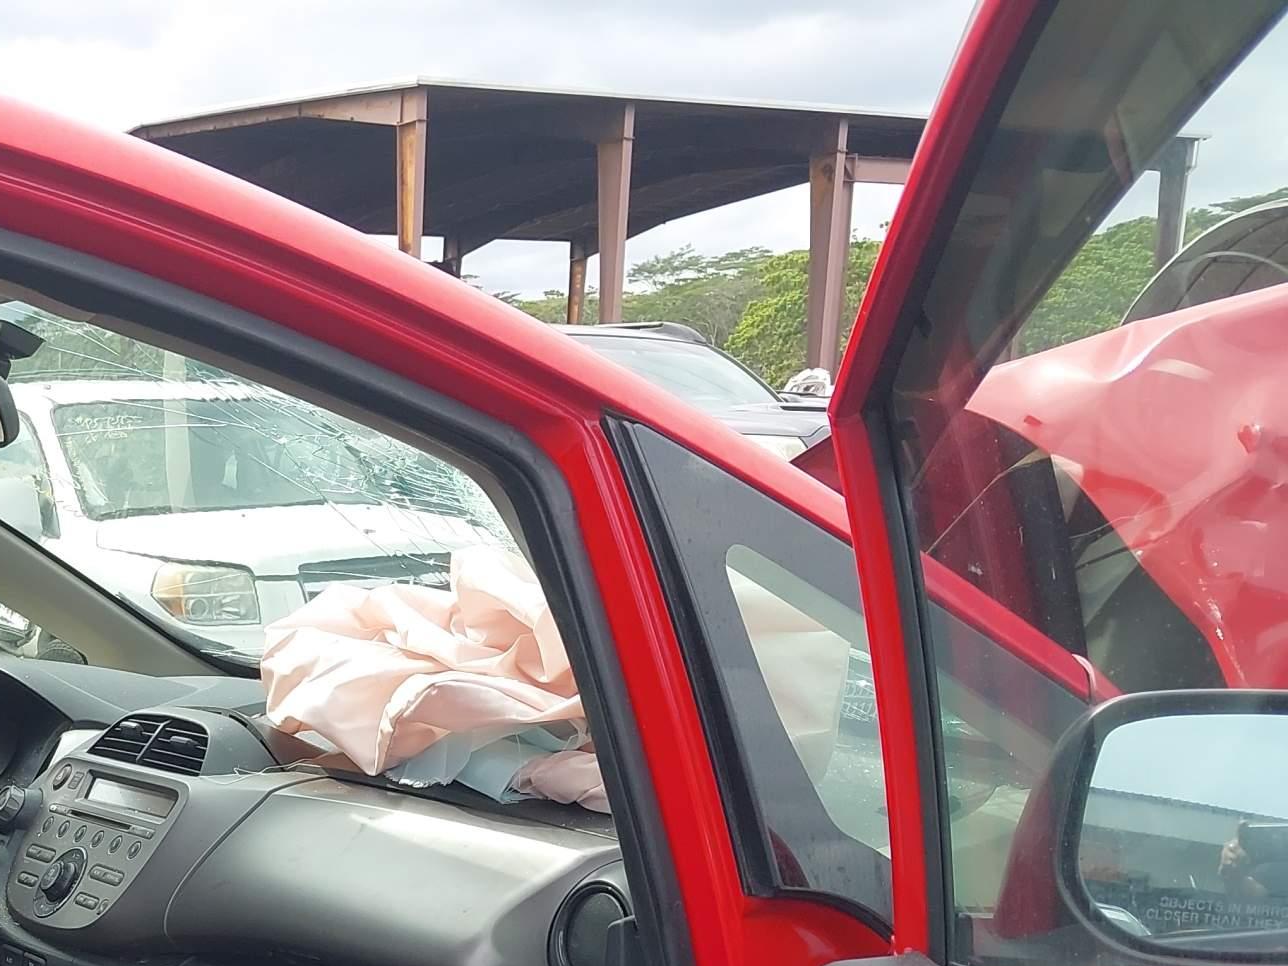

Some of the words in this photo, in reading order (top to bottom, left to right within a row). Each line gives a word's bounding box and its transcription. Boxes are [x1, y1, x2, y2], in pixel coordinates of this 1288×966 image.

[1159, 896, 1224, 912] OBJECTS
[1228, 903, 1241, 914] IN
[1146, 908, 1199, 922] CLOSER
[1203, 913, 1241, 926] THAN
[1247, 917, 1283, 929] THEY
